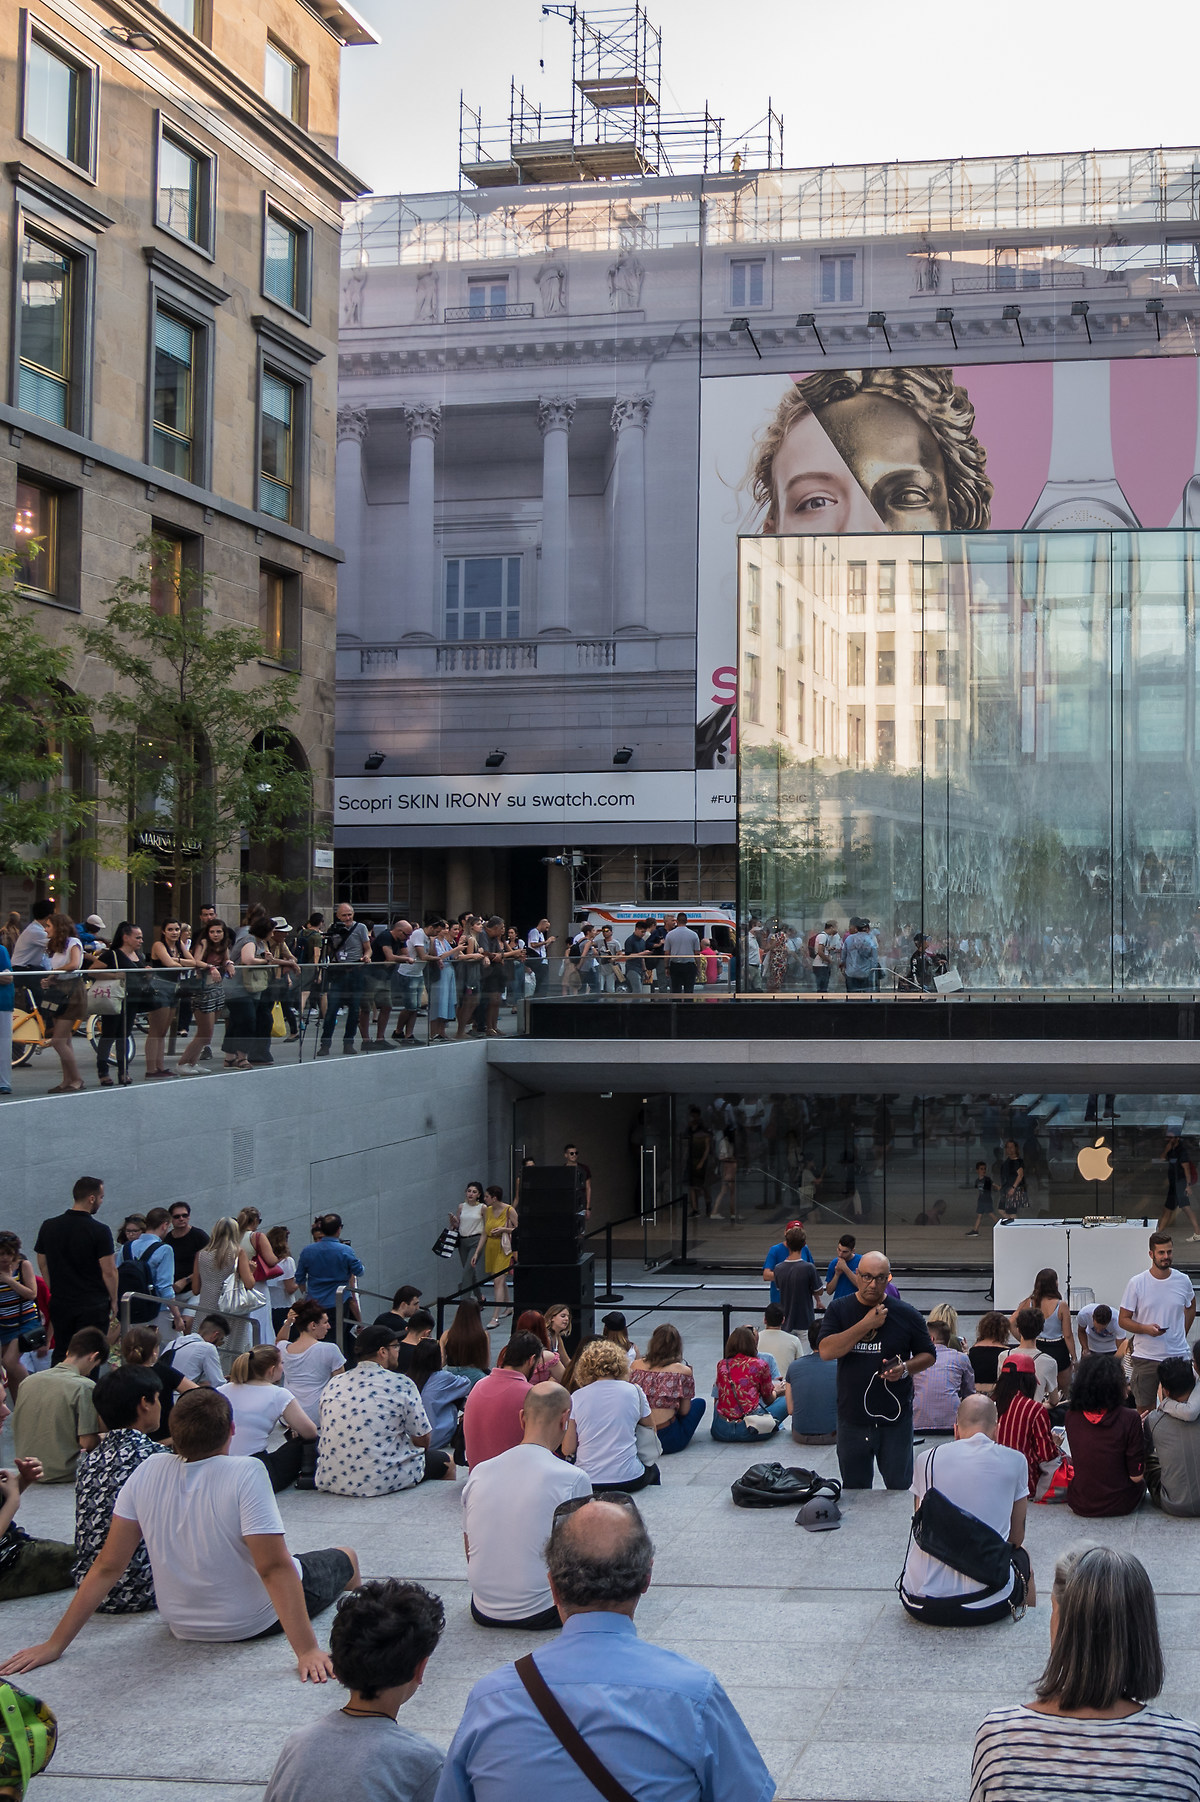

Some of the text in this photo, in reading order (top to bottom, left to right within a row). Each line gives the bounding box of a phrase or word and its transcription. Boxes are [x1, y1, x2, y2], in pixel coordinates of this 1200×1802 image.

[338, 792, 635, 814] Scopri SKIN IRONY su swatch.com
